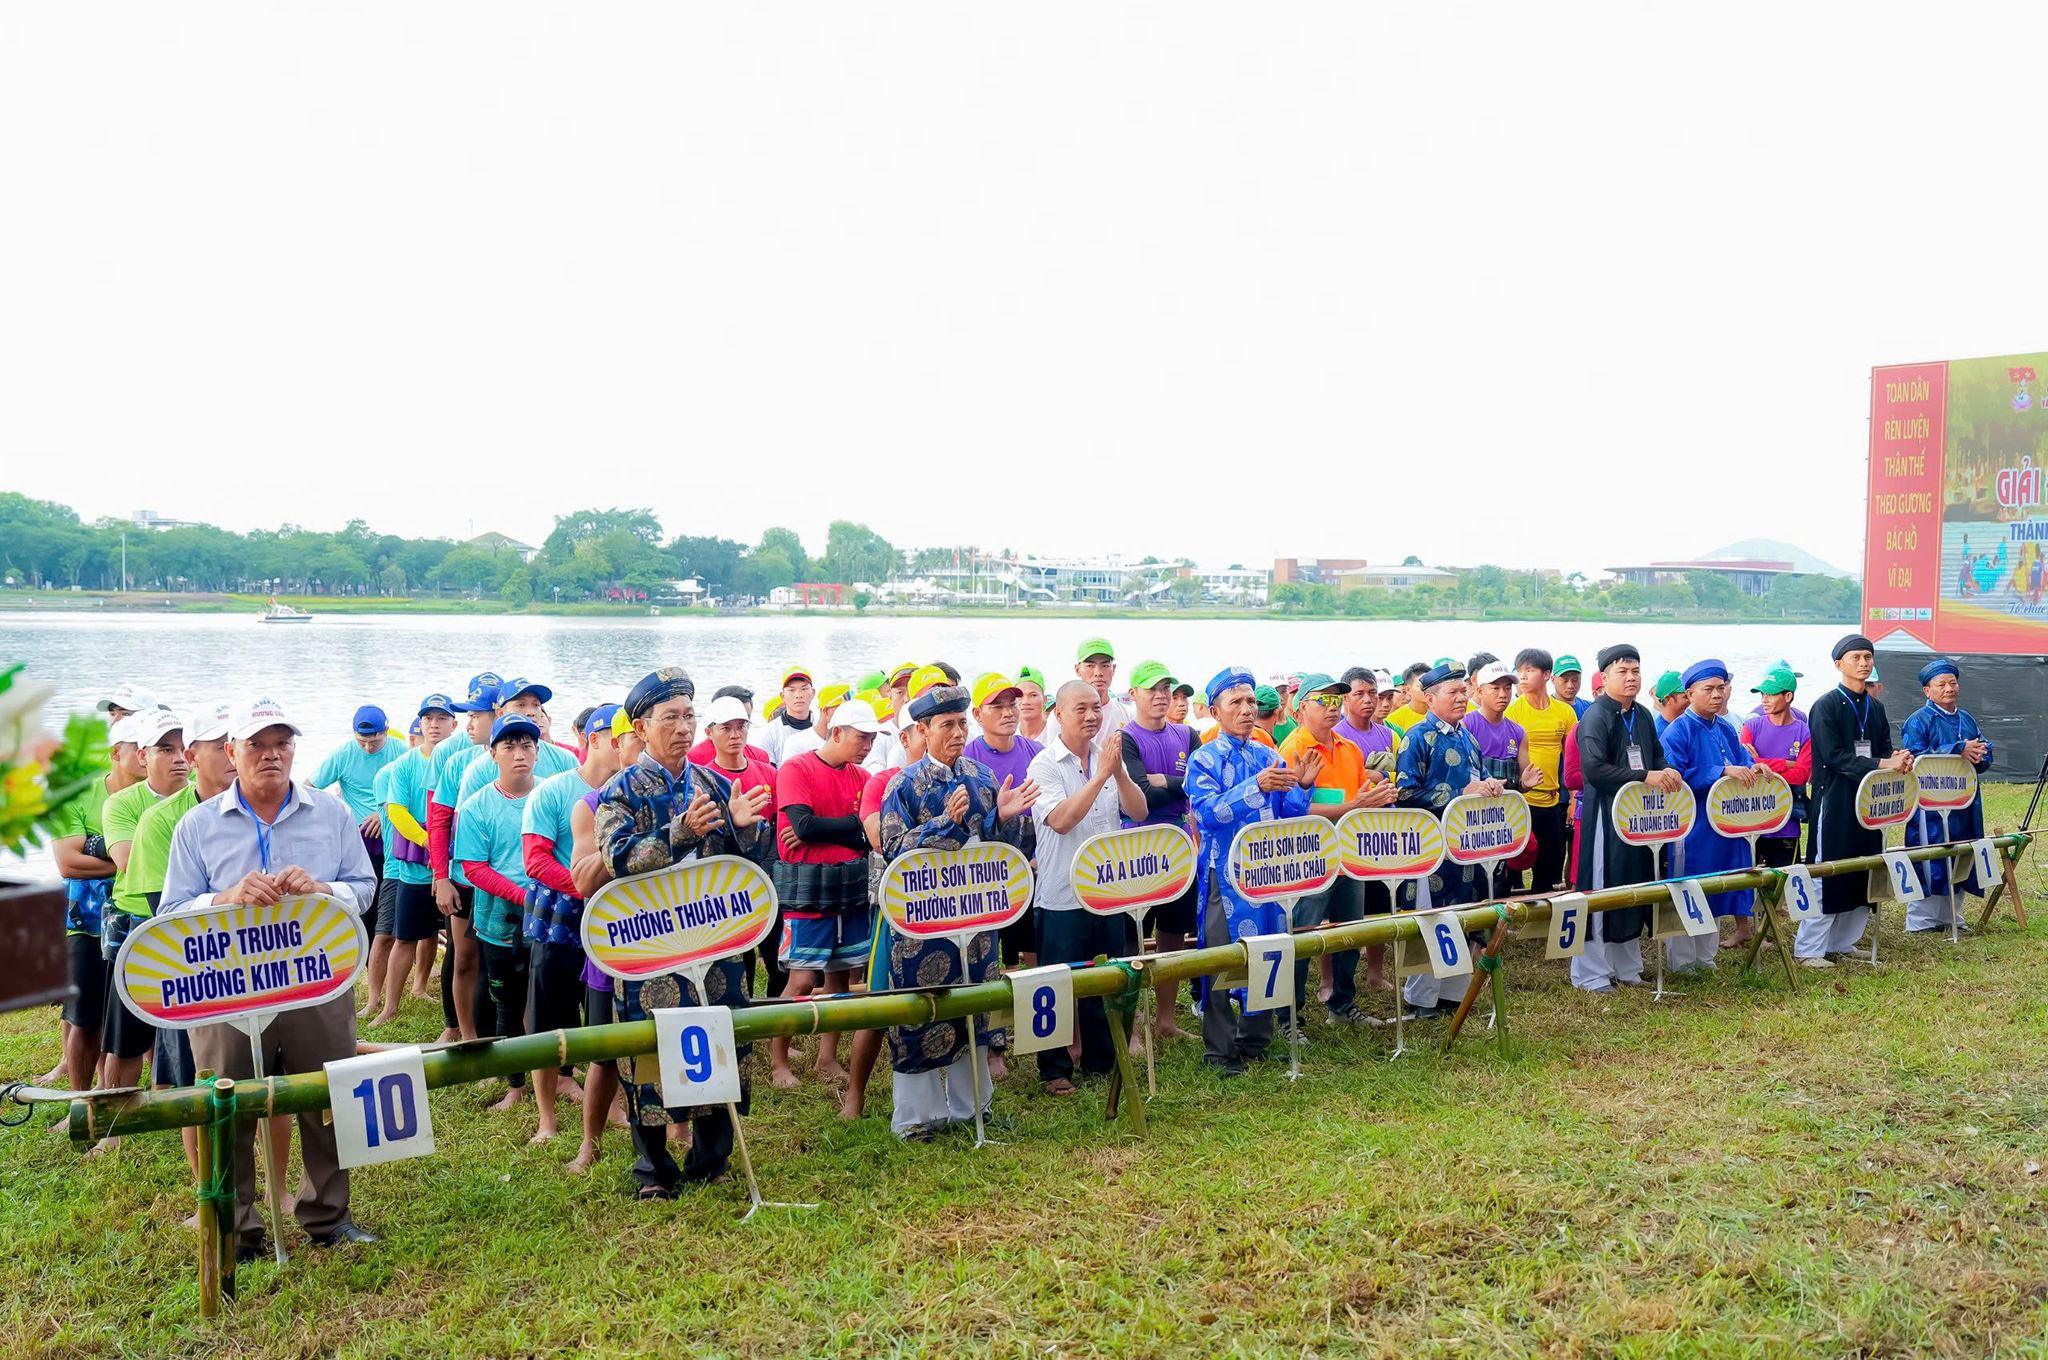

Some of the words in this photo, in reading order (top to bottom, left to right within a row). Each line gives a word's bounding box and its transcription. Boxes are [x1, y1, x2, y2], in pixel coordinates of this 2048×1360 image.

[1886, 376, 1909, 403] TOÀN
[1911, 375, 1929, 402] DÂN
[1884, 414, 1901, 440] RÈN
[1904, 413, 1929, 444] LUYỆN
[1884, 450, 1907, 478] THÂN
[1997, 457, 2040, 507] GIẢI
[1875, 494, 1896, 514] THEO
[1899, 493, 1931, 513] GƯƠNG
[1886, 525, 1902, 551] BÁC
[1905, 522, 1917, 550] HỒ
[1888, 563, 1896, 588] VĨ
[1899, 568, 1912, 592] ĐẠI
[1872, 779, 1890, 799] QUẢNG
[1892, 780, 1904, 795] VINH
[1959, 777, 1966, 789] AN
[1643, 790, 1655, 810] THỦ
[1722, 795, 1749, 815] PHƯỜNG
[1751, 796, 1760, 811] AN
[1762, 793, 1776, 813] CỰU
[1869, 801, 1877, 817] XÃ
[1466, 810, 1480, 827] MAI
[1481, 806, 1505, 824] DƯƠNG
[1629, 814, 1638, 832] XÃ
[1640, 811, 1662, 833] QUẢNG
[1664, 810, 1679, 830] ĐIỀN
[1249, 834, 1273, 861] TRIỀU
[1276, 836, 1294, 857] SƠN
[1296, 832, 1320, 854] ĐÔNG
[1356, 832, 1398, 862] TRỌNG
[1401, 827, 1421, 856] TÀI
[1460, 831, 1470, 850] XÃ
[1471, 827, 1495, 850] QUẢNG
[1496, 823, 1513, 845] ĐIỀN
[902, 862, 937, 893] TRIỀU
[941, 863, 966, 887] SƠN
[969, 860, 1009, 885] TRUNG
[1096, 860, 1114, 884] XÃ
[1118, 861, 1127, 880] A
[1130, 852, 1158, 879] LƯỚI
[1161, 854, 1169, 872] 4
[1245, 863, 1281, 888] PHƯỜNG
[1284, 859, 1302, 882] HÓA
[1303, 856, 1326, 879] CHÂU
[1895, 861, 1913, 894] 2
[1981, 847, 1992, 878] 1
[906, 893, 957, 923] PHƯỜNG
[960, 893, 984, 916] KIM
[986, 885, 1010, 912] TRÀ
[1682, 889, 1703, 924] 4
[1792, 875, 1809, 912] 3
[607, 909, 674, 947] PHƯỜNG
[675, 894, 728, 928] THUẬN
[730, 890, 753, 917] AN
[1559, 909, 1577, 949] 5
[184, 928, 231, 964] GIÁP
[236, 919, 302, 955] TRUNG
[1435, 923, 1459, 966] 6
[161, 967, 246, 1007] PHƯỜNG
[251, 959, 290, 992] KIM
[294, 948, 332, 983] TRÀ
[1263, 950, 1282, 998] 7
[1033, 985, 1056, 1038] 8
[681, 1025, 712, 1083] 9
[353, 1073, 417, 1148] 10
